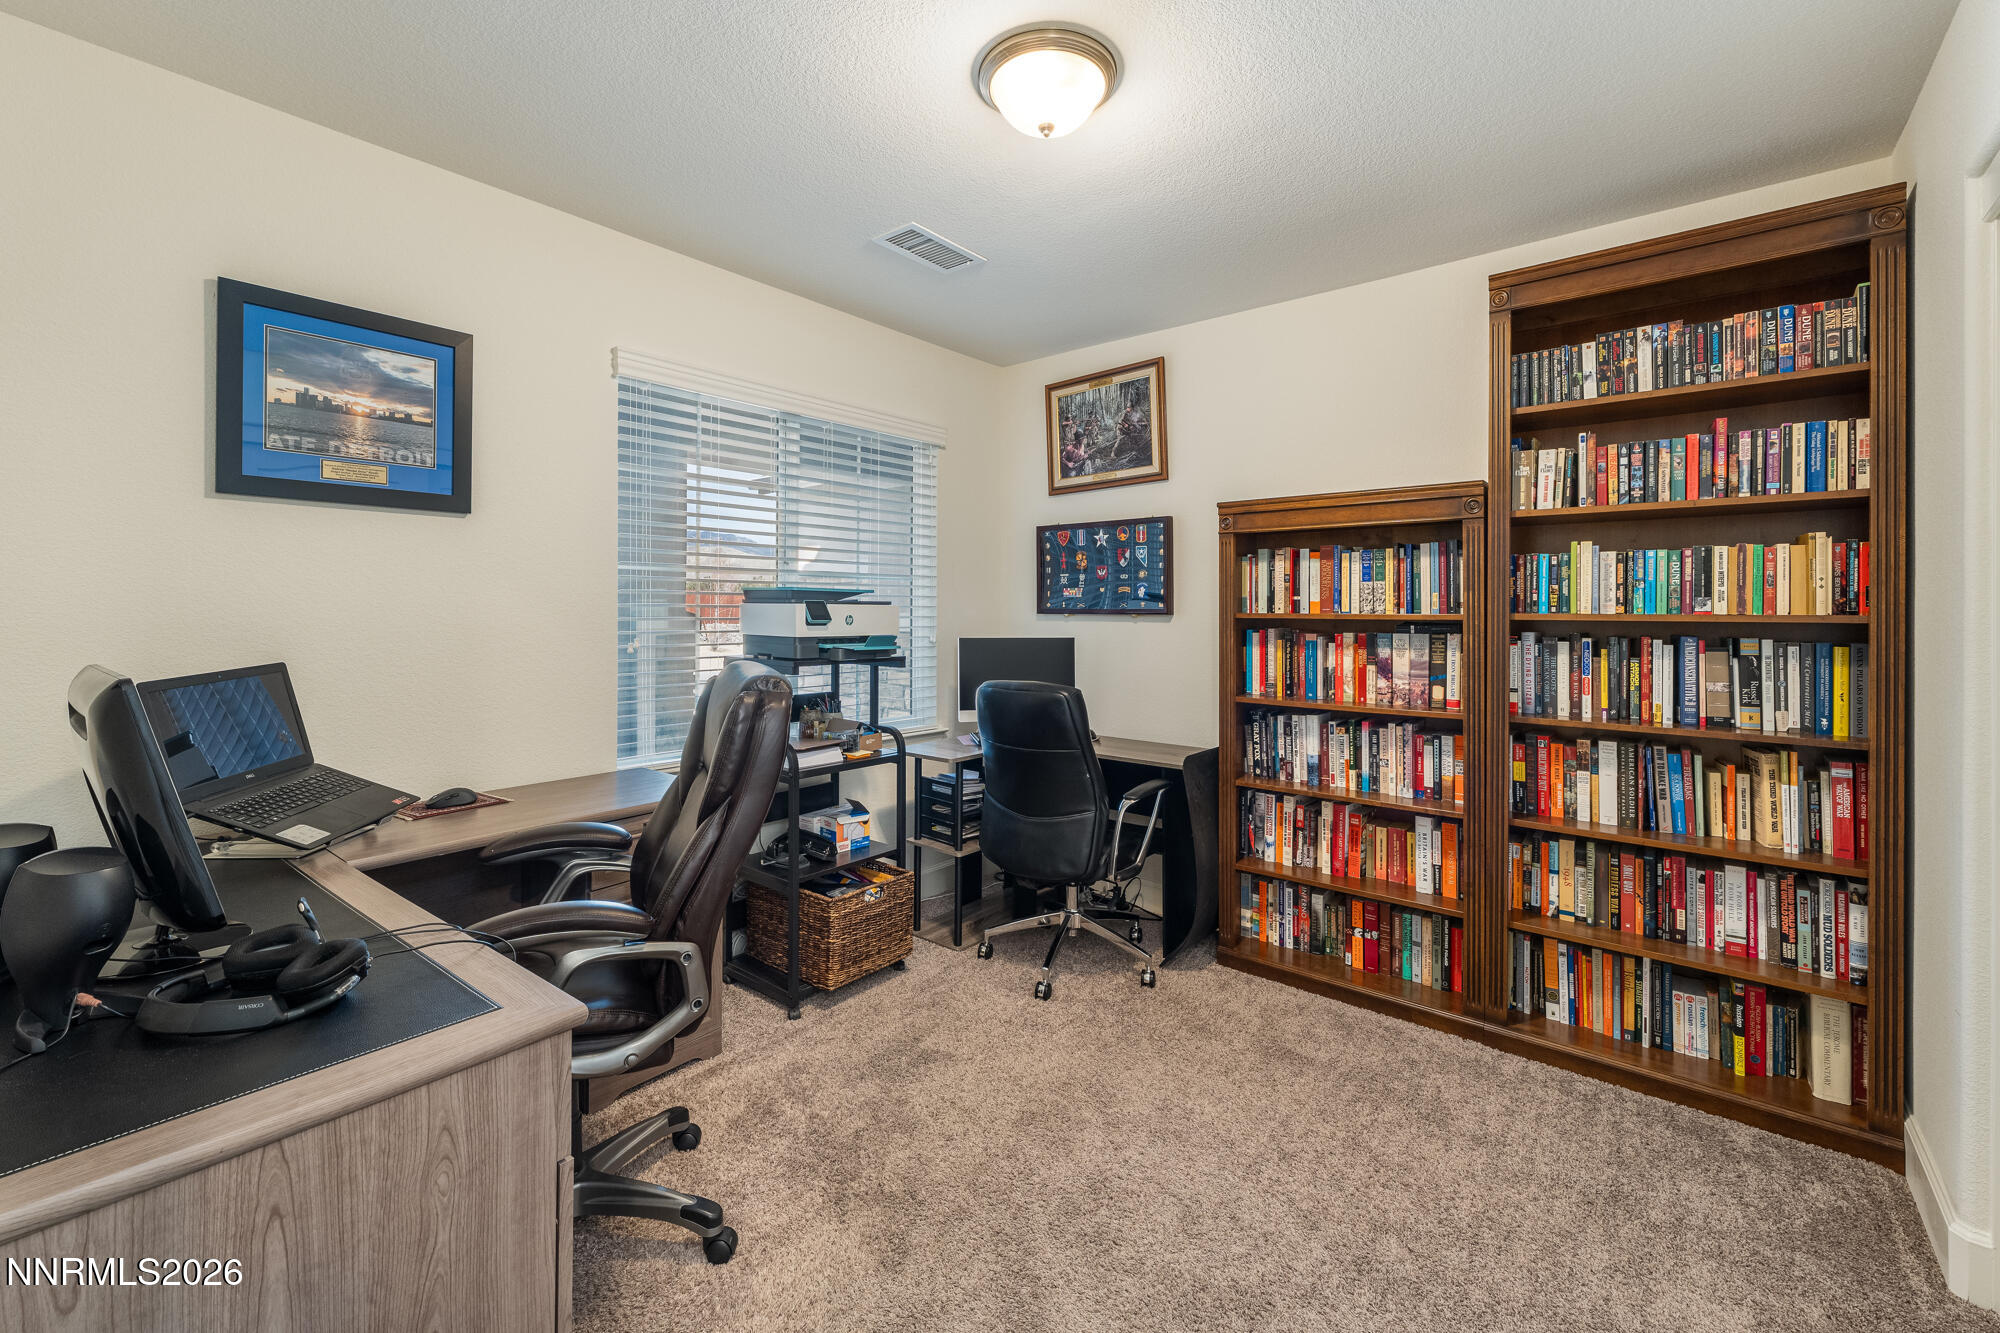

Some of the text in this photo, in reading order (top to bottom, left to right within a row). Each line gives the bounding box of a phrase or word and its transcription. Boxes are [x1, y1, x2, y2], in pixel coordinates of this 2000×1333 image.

[1802, 315, 1811, 341] DUNE
[1825, 309, 1835, 330] DUNE
[1842, 307, 1852, 328] DUNE
[1767, 320, 1775, 344] DUNE
[1784, 318, 1792, 342] DUNE
[1742, 681, 1760, 705] Russell Kirk
[1857, 697, 1863, 705] OF
[1656, 748, 1664, 761] HOW
[1657, 771, 1665, 787] MAKE
[1684, 766, 1692, 800] FIREARMS
[1659, 788, 1667, 800] WAR
[1563, 868, 1572, 887] 1948
[1623, 880, 1634, 895] WARS
[1823, 914, 1833, 972] MUD SOLDIERS
[1824, 1041, 1832, 1088] COMMENTARY
